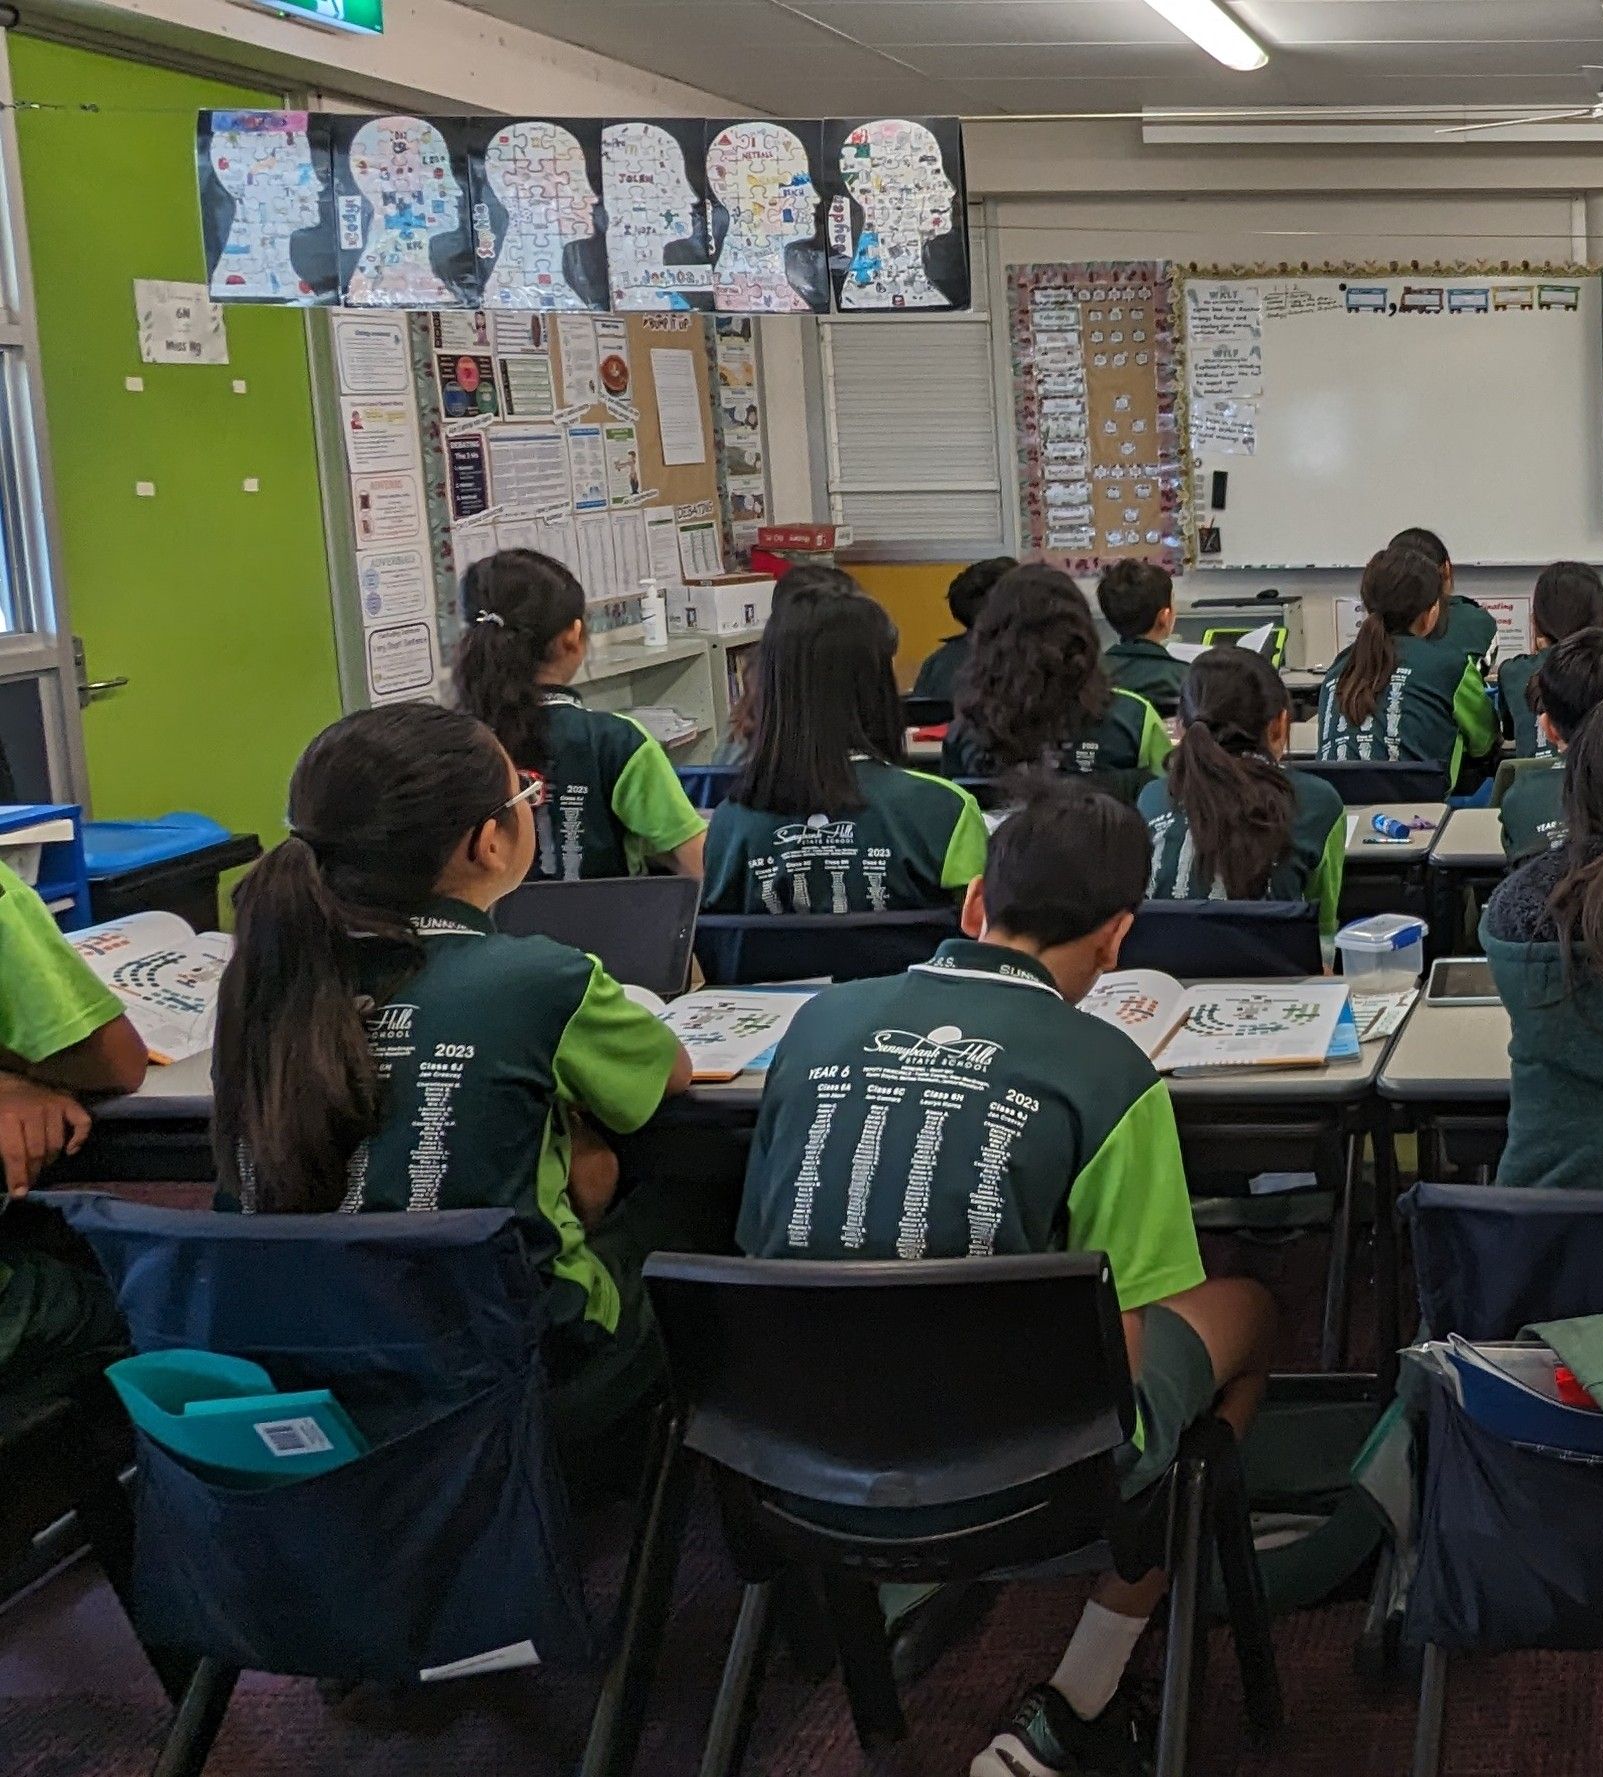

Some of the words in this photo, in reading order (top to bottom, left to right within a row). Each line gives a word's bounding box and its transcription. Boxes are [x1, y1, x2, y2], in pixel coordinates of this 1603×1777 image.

[867, 847, 891, 858] 2023
[366, 1008, 413, 1031] Hills
[434, 1043, 476, 1059] 2023
[864, 1032, 941, 1062] Sunnybank
[947, 1042, 999, 1066] Hills
[419, 1062, 447, 1071] Class
[450, 1062, 464, 1072] 6J
[905, 1056, 936, 1066] STATE
[941, 1057, 989, 1073] SCHOOL
[808, 1066, 837, 1081] YEAR
[840, 1065, 851, 1078] 6
[817, 1084, 837, 1092] Class
[866, 1084, 891, 1095] Class
[923, 1089, 949, 1101] Class
[1005, 1088, 1040, 1112] 2023
[989, 1101, 1015, 1117] Class
